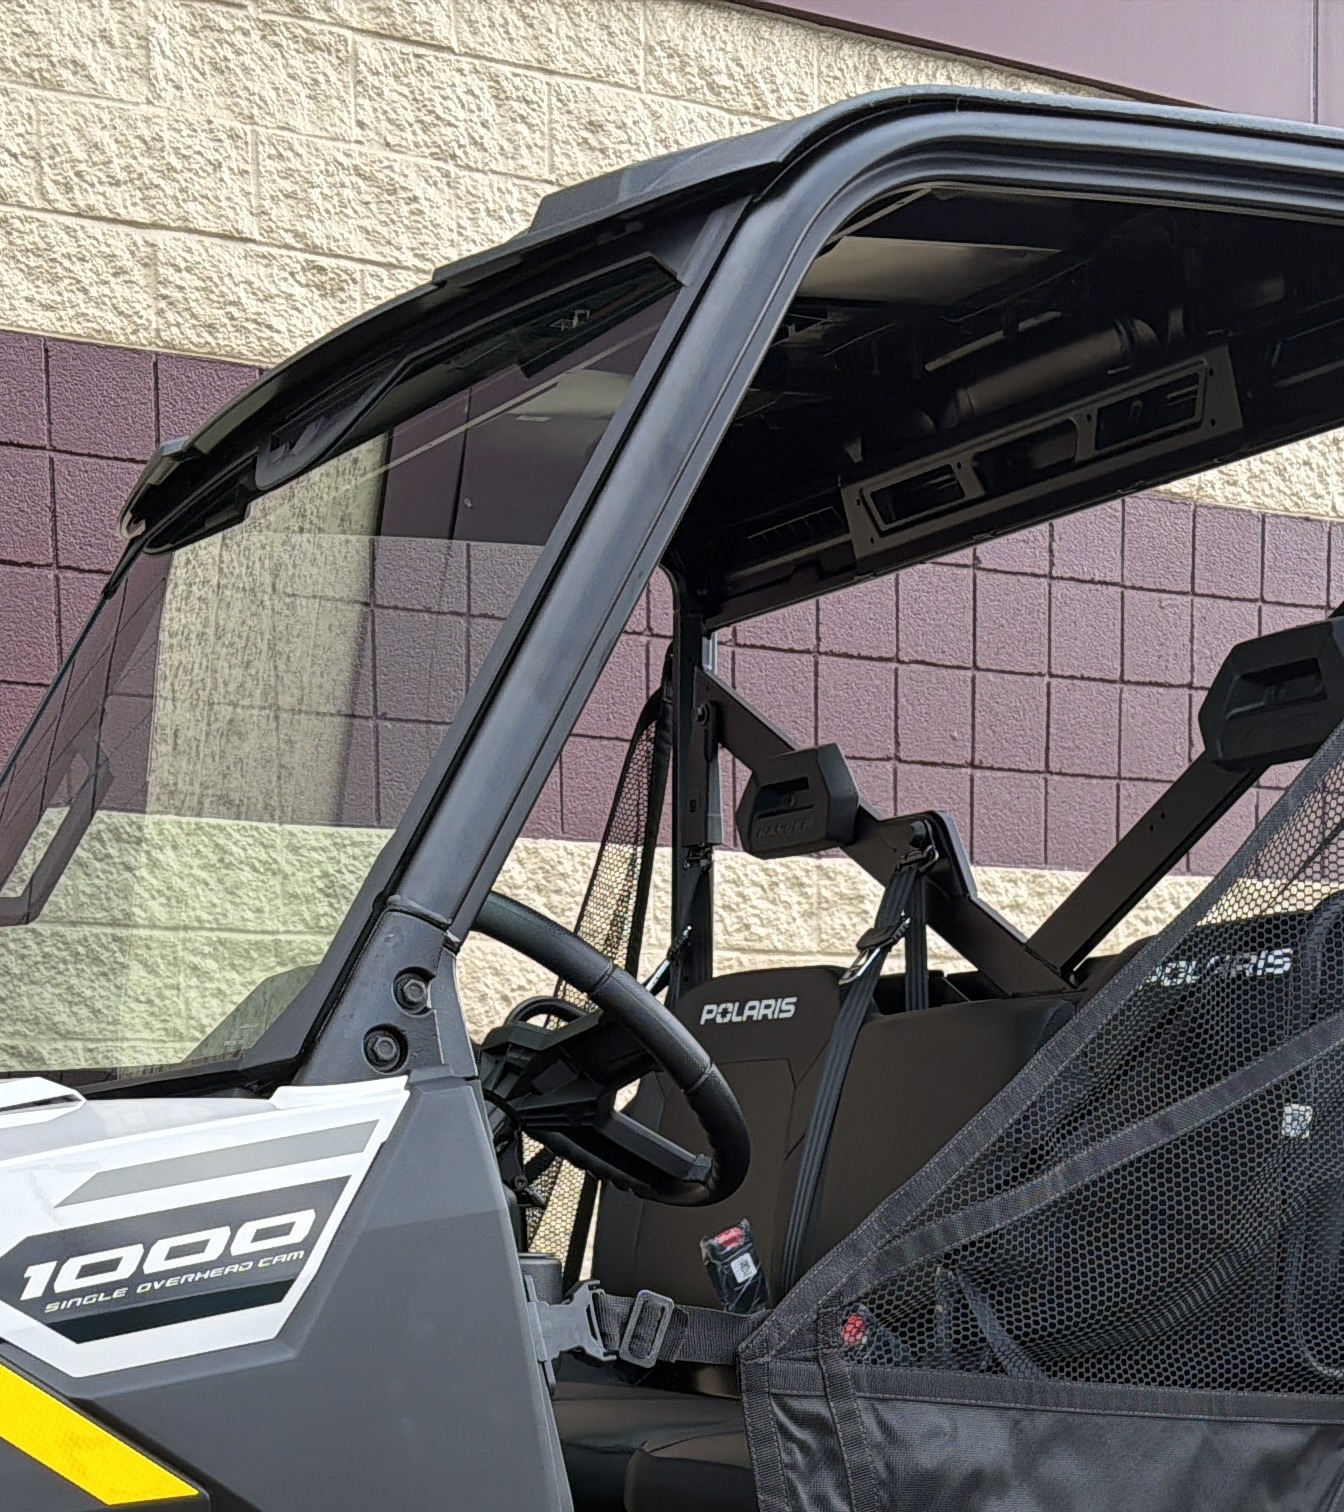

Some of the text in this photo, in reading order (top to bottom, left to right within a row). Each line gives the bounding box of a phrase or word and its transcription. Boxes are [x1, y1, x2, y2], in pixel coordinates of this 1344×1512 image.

[699, 996, 798, 1026] POLARIS
[19, 1208, 317, 1302] 1000
[44, 1249, 306, 1314] SINGLE OVERHEAD CAM
